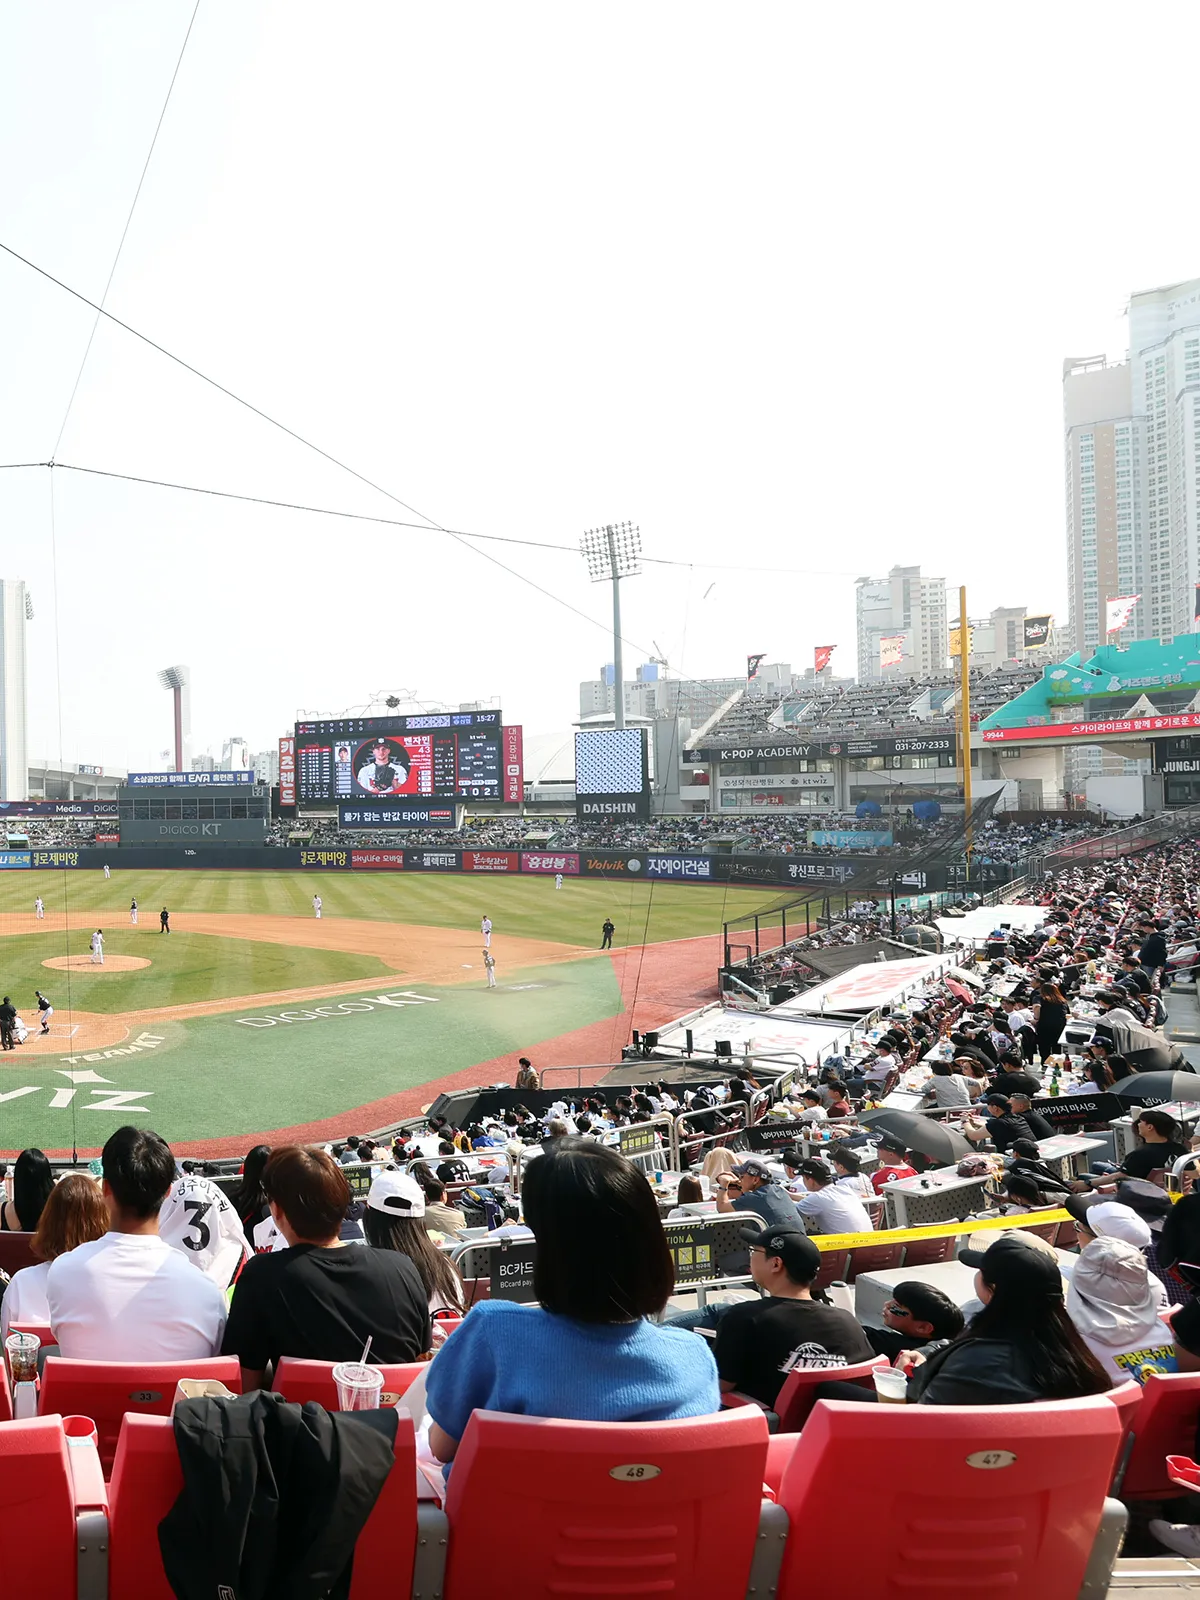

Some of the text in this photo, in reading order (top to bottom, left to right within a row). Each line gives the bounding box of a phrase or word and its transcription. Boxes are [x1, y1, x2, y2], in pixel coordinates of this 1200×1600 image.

[1072, 716, 1189, 733] 스카이라이프와 함께 슬기로운
[404, 736, 430, 746] 벤자민
[508, 727, 516, 762] 대신증권
[722, 746, 810, 759] K-POP ACADEMY
[188, 774, 210, 782] ENA
[281, 740, 295, 804] 키즈랜드
[812, 775, 827, 784] wiz
[583, 803, 636, 813] DAISHIN
[344, 812, 360, 821] 물가
[363, 812, 380, 821] 잡는
[382, 811, 400, 821] 반값
[402, 811, 428, 821] 타이어
[159, 824, 221, 835] DIGICO KT
[39, 852, 78, 866] 로제비앙
[307, 851, 347, 866] 로제비앙
[352, 854, 403, 864] skylife 모바일
[422, 856, 456, 866] 셀렉티브
[587, 859, 624, 870] Volvik
[649, 859, 710, 876] 지에이건설
[788, 864, 855, 883] 광신프로그레스
[236, 991, 440, 1027] DIGICO KT
[60, 1032, 165, 1063] TEAM KT
[1033, 1102, 1097, 1115] 넘어가지 마시오
[760, 1130, 785, 1140] 넘어가지
[182, 1200, 212, 1251] 3
[499, 1262, 533, 1276] BC카드
[500, 1280, 521, 1288] BCcard
[982, 1454, 1001, 1464] 47
[626, 1468, 644, 1478] 48
